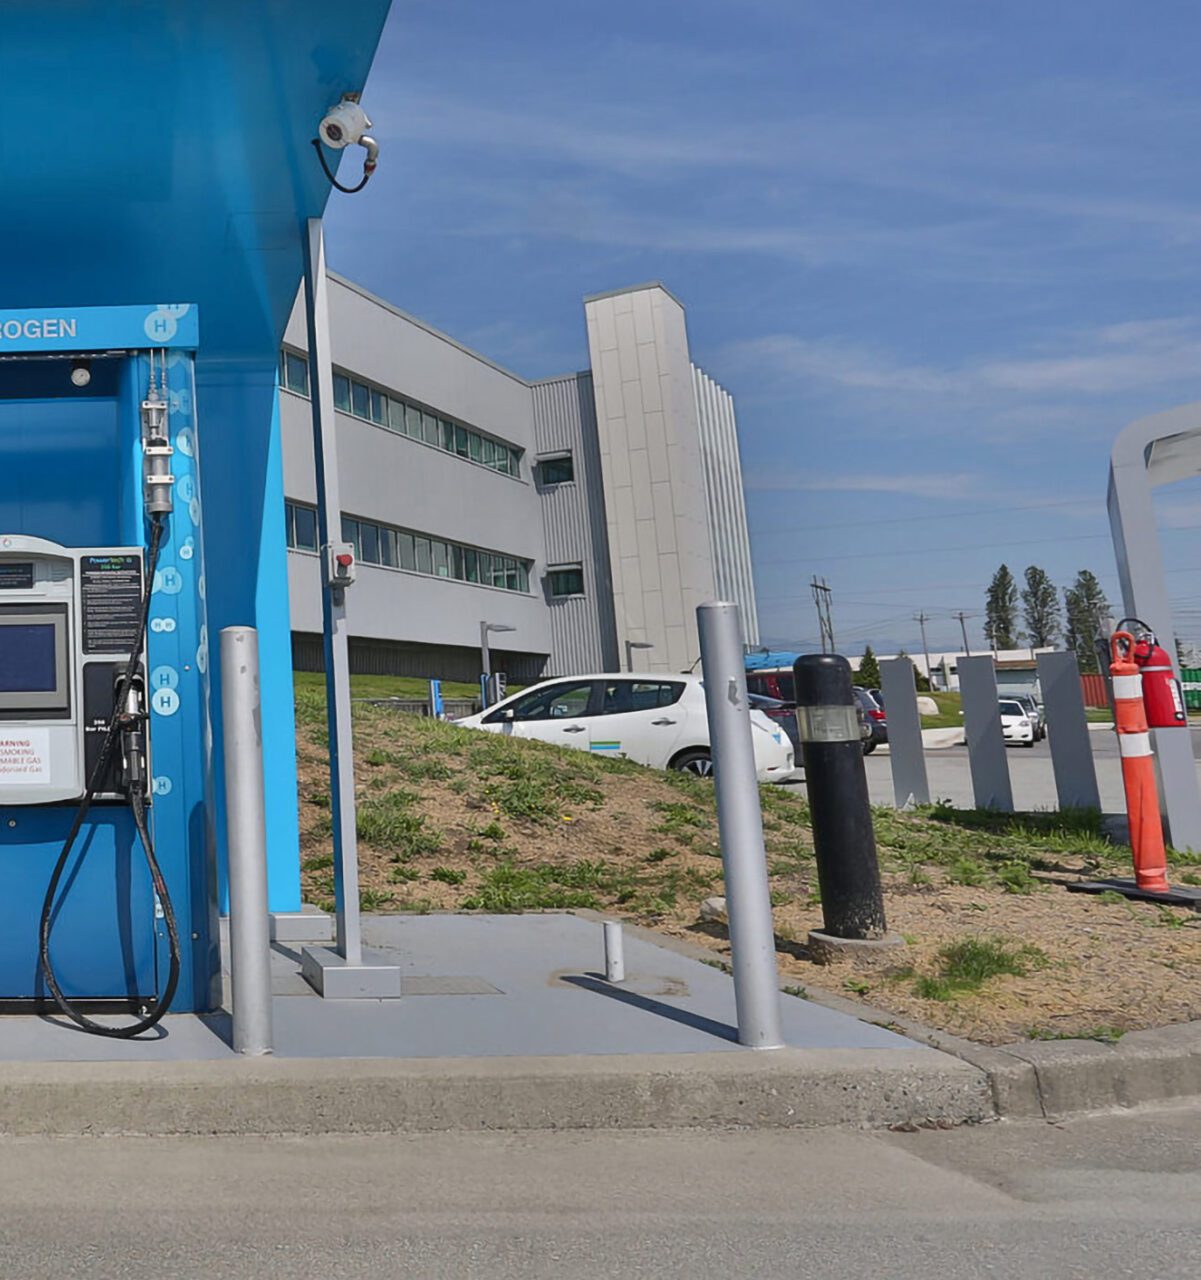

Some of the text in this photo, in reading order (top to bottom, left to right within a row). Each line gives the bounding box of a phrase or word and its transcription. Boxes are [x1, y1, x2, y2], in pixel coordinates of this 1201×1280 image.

[154, 319, 167, 333] H
[164, 574, 176, 587] H
[160, 673, 170, 686] H
[161, 696, 171, 708] H
[0, 748, 35, 756] SMOKING
[26, 757, 42, 765] GAS
